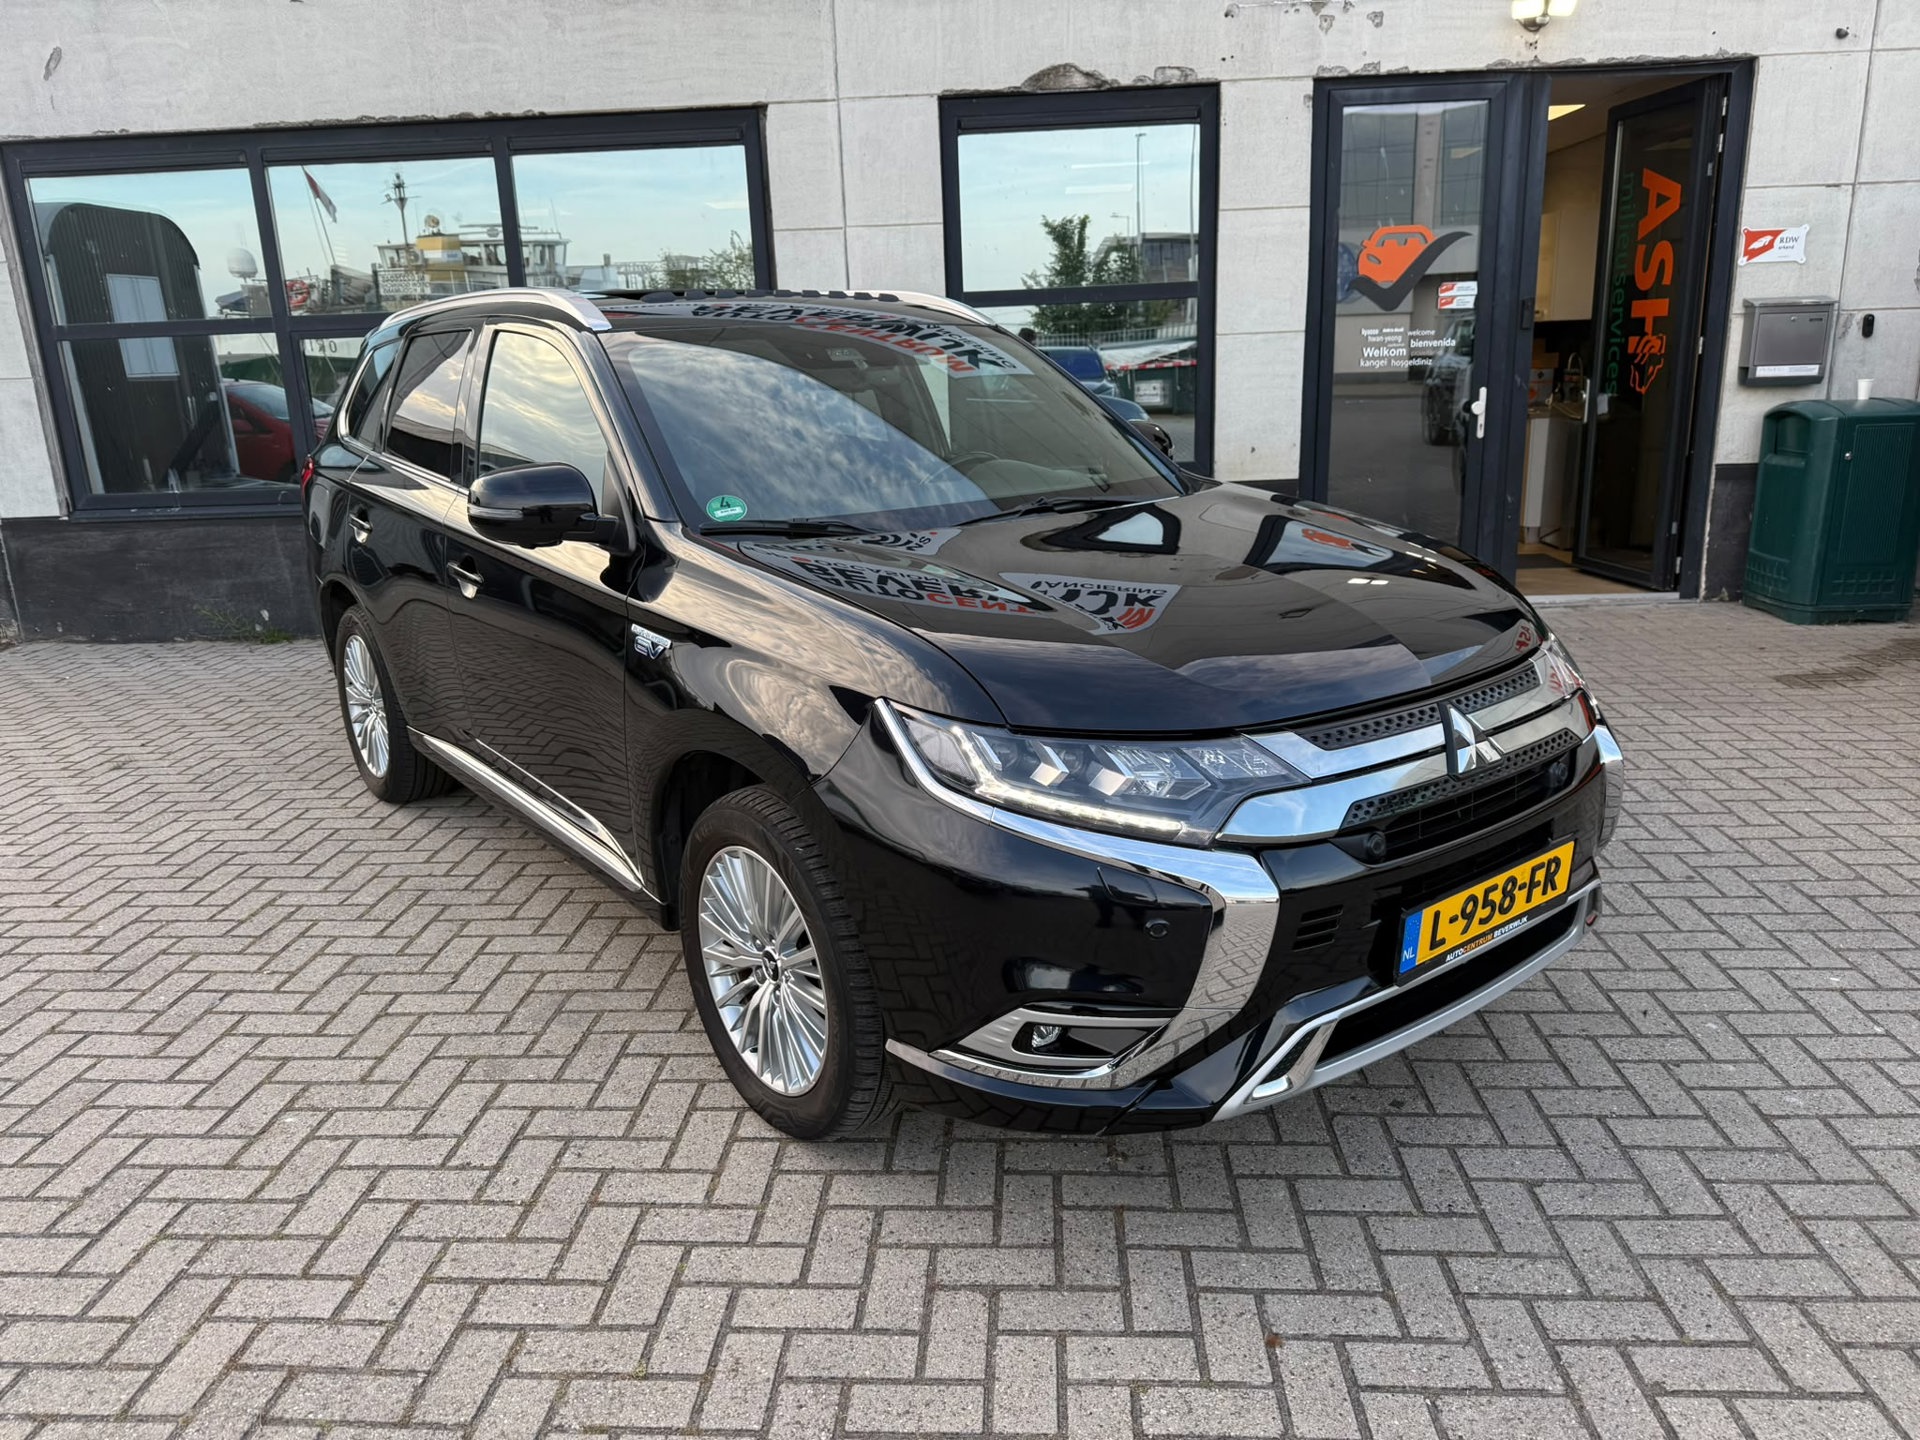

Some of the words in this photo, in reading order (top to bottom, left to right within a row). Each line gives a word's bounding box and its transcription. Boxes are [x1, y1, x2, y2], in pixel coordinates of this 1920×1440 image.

[1779, 236, 1800, 244] RDW
[1628, 168, 1682, 354] ASH
[1407, 329, 1436, 337] welcome
[1410, 338, 1456, 348] bienvenida
[1362, 347, 1407, 358] Welkom
[1429, 856, 1562, 951] L-958-FR
[1446, 933, 1494, 962] AUTOCENTRUM
[1493, 915, 1528, 938] BEVERWIJK
[1402, 946, 1415, 962] NL
